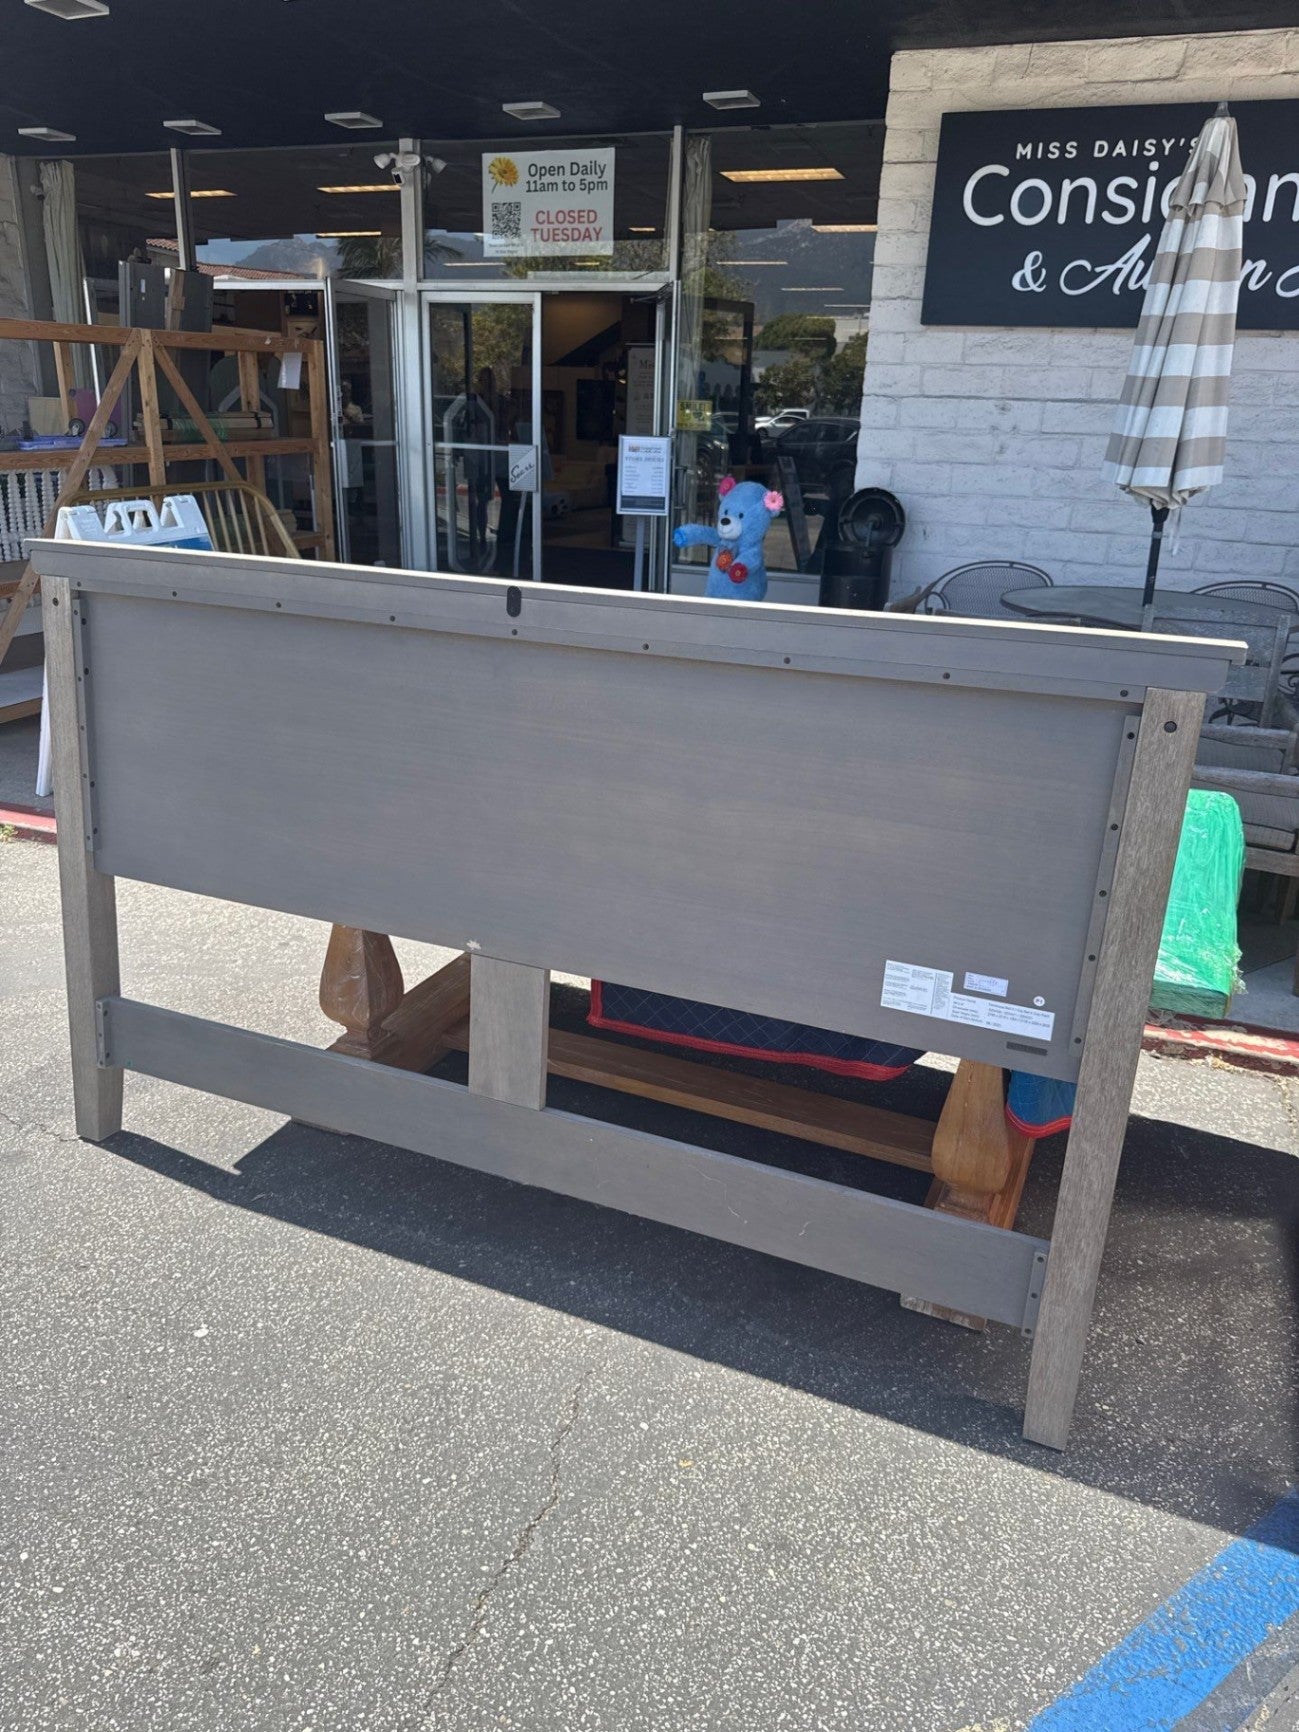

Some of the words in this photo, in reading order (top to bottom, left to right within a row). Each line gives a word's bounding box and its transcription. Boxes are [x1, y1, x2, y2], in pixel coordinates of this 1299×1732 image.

[1016, 141, 1079, 159] MISS
[528, 163, 566, 180] Open
[570, 160, 607, 178] Daily
[525, 180, 558, 193] 11am
[562, 180, 576, 191] to
[579, 178, 608, 194] 5pm
[535, 209, 598, 225] CLOSED
[530, 227, 603, 242] TUESDAY
[1011, 250, 1047, 292] &
